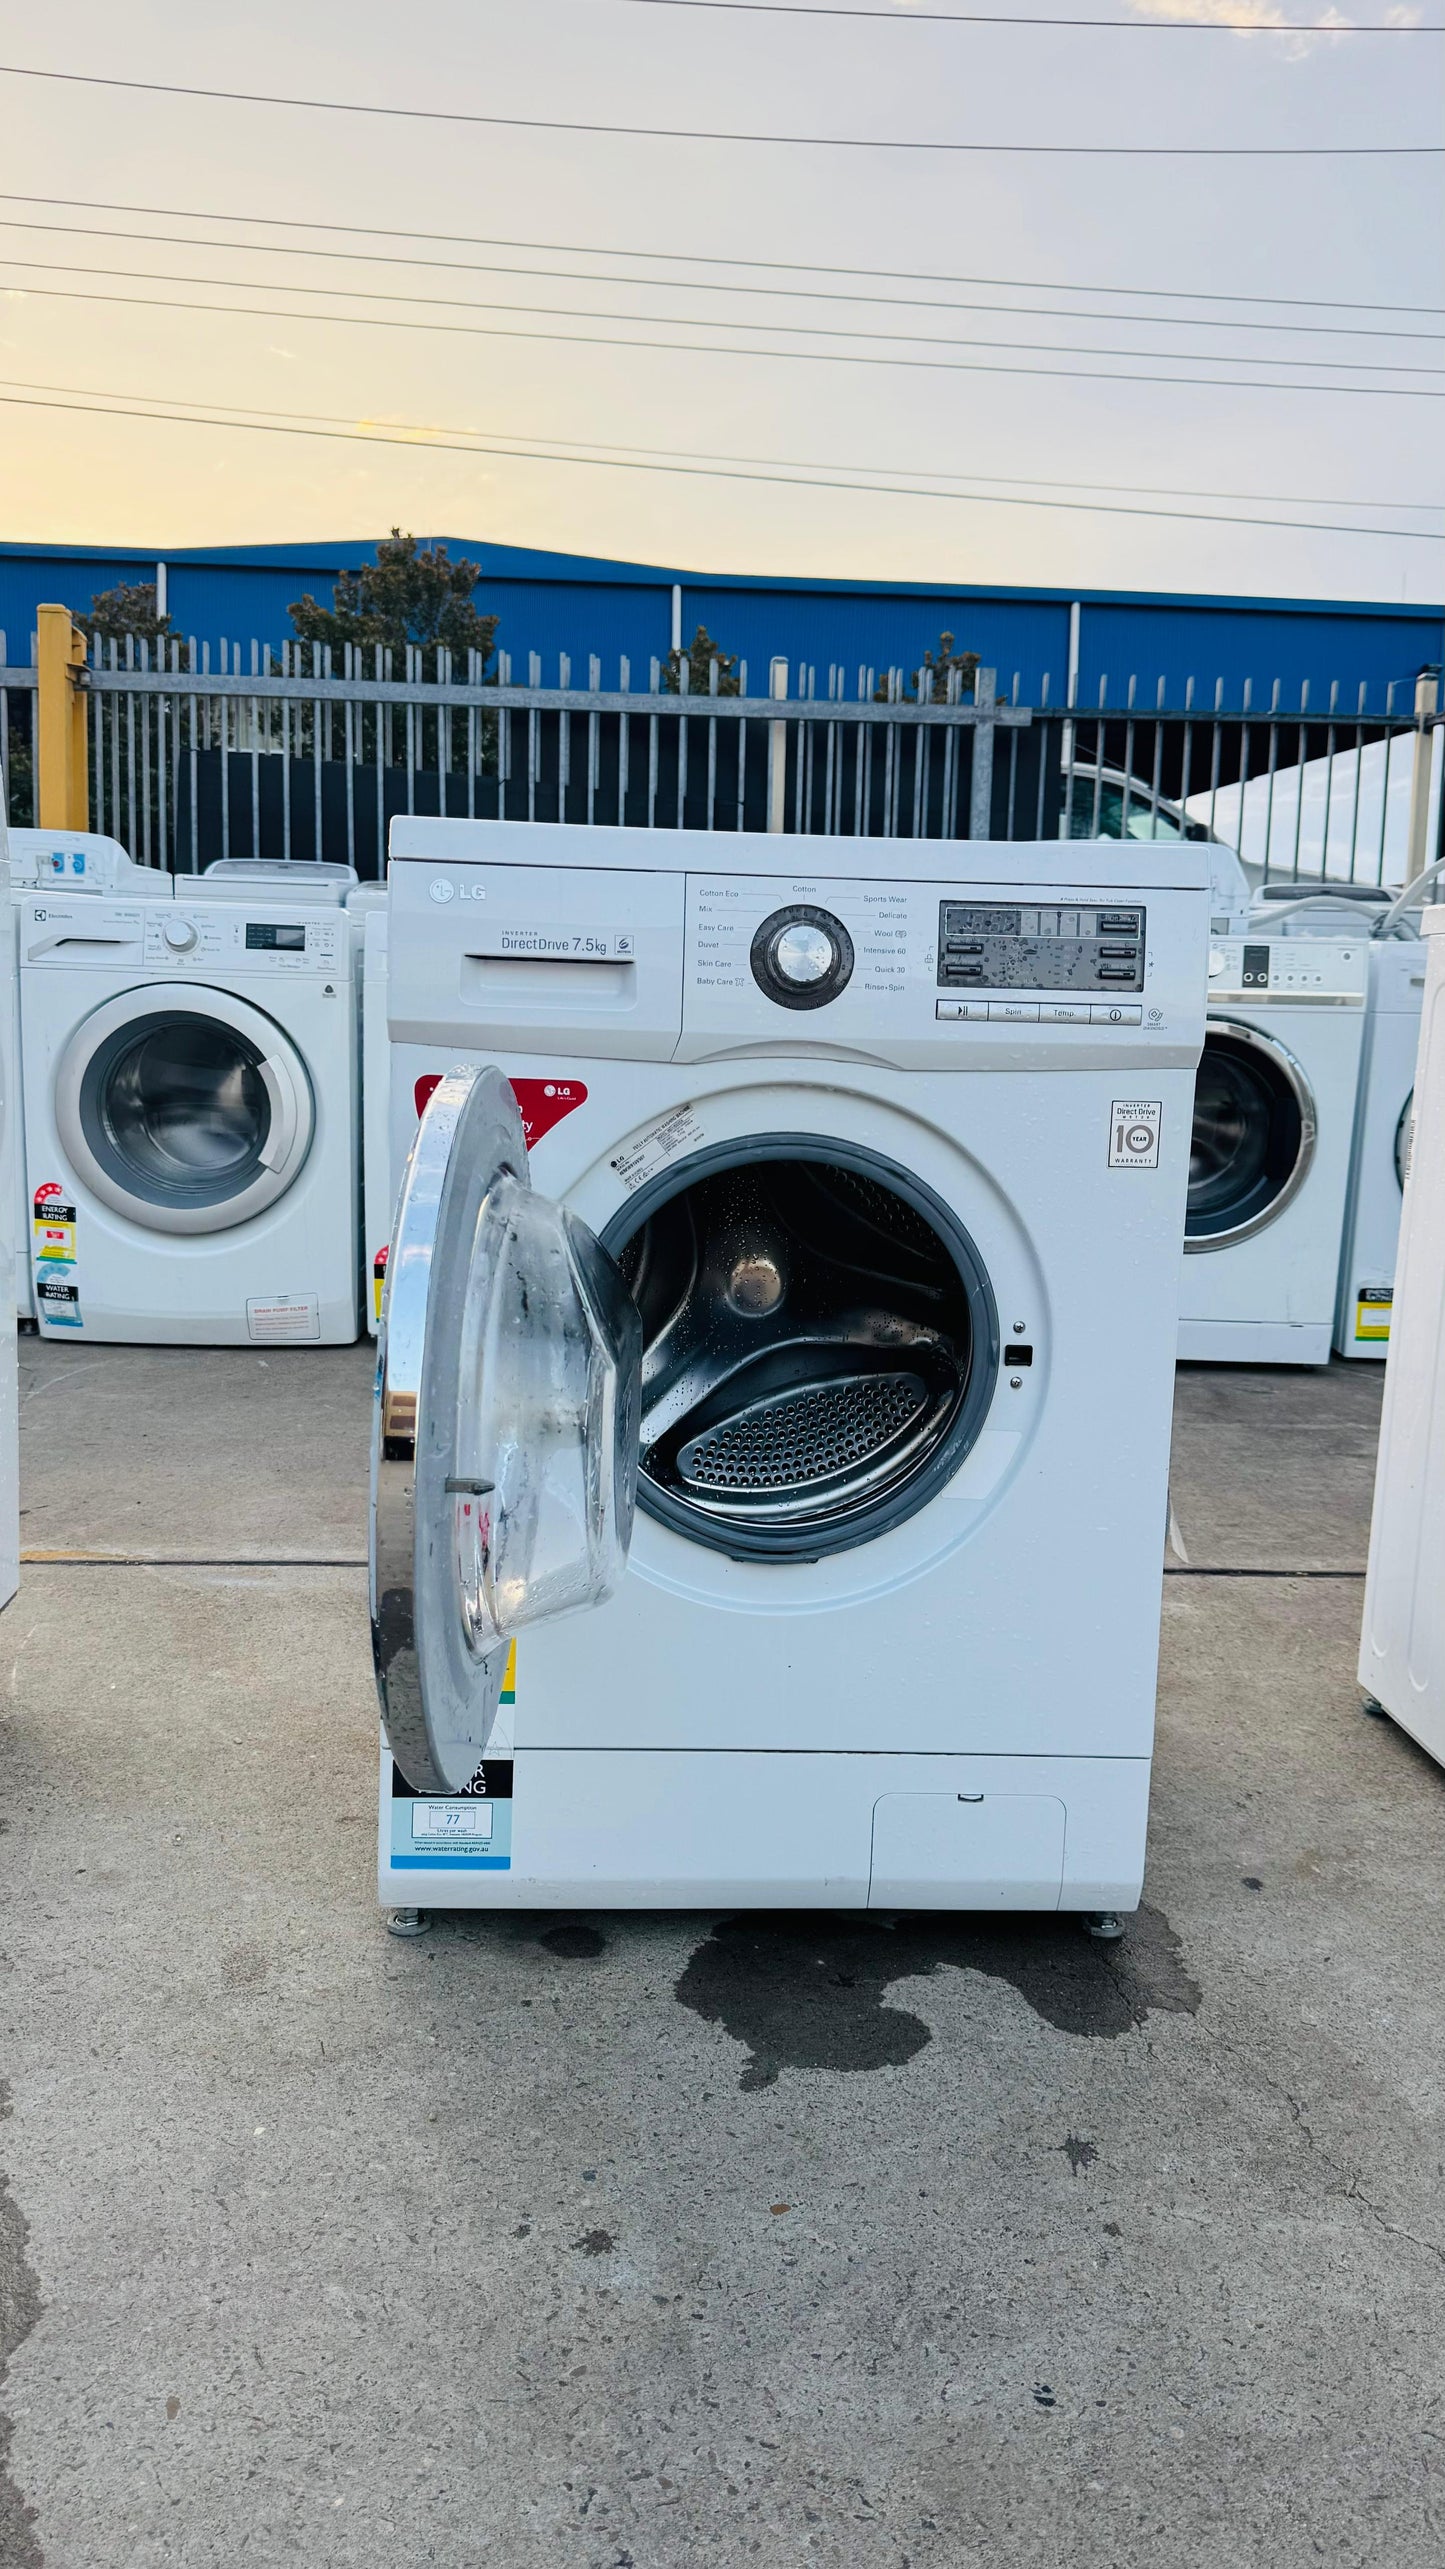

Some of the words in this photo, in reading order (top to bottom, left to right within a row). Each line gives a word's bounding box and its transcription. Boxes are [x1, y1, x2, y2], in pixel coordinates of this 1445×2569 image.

[459, 884, 486, 900] LG
[699, 889, 723, 897] Cotton
[725, 890, 739, 898] Eco
[863, 895, 887, 905] Sports
[888, 896, 908, 904] Wear
[699, 905, 713, 913] Mix
[878, 912, 908, 920] Delicate
[698, 924, 716, 933] Easy
[717, 924, 734, 932] Care
[697, 941, 719, 949] Duvet
[897, 947, 906, 955] 60
[715, 960, 732, 968] Care
[874, 966, 895, 974] Quick
[896, 966, 905, 974] 30
[696, 977, 715, 987] Baby
[716, 978, 734, 986] Care
[1005, 1008, 1022, 1016] Spin
[1054, 1009, 1076, 1017] Temp.
[557, 1087, 571, 1096] LG
[1117, 1107, 1137, 1115] Direct
[1138, 1108, 1156, 1116] Drive
[1116, 1124, 1155, 1154] 10
[616, 1155, 625, 1164] LG
[41, 1205, 68, 1214] ENERGY
[42, 1213, 68, 1221] RATING
[45, 1285, 70, 1293] WATER
[45, 1292, 70, 1300] RATING
[446, 1814, 460, 1825] 77
